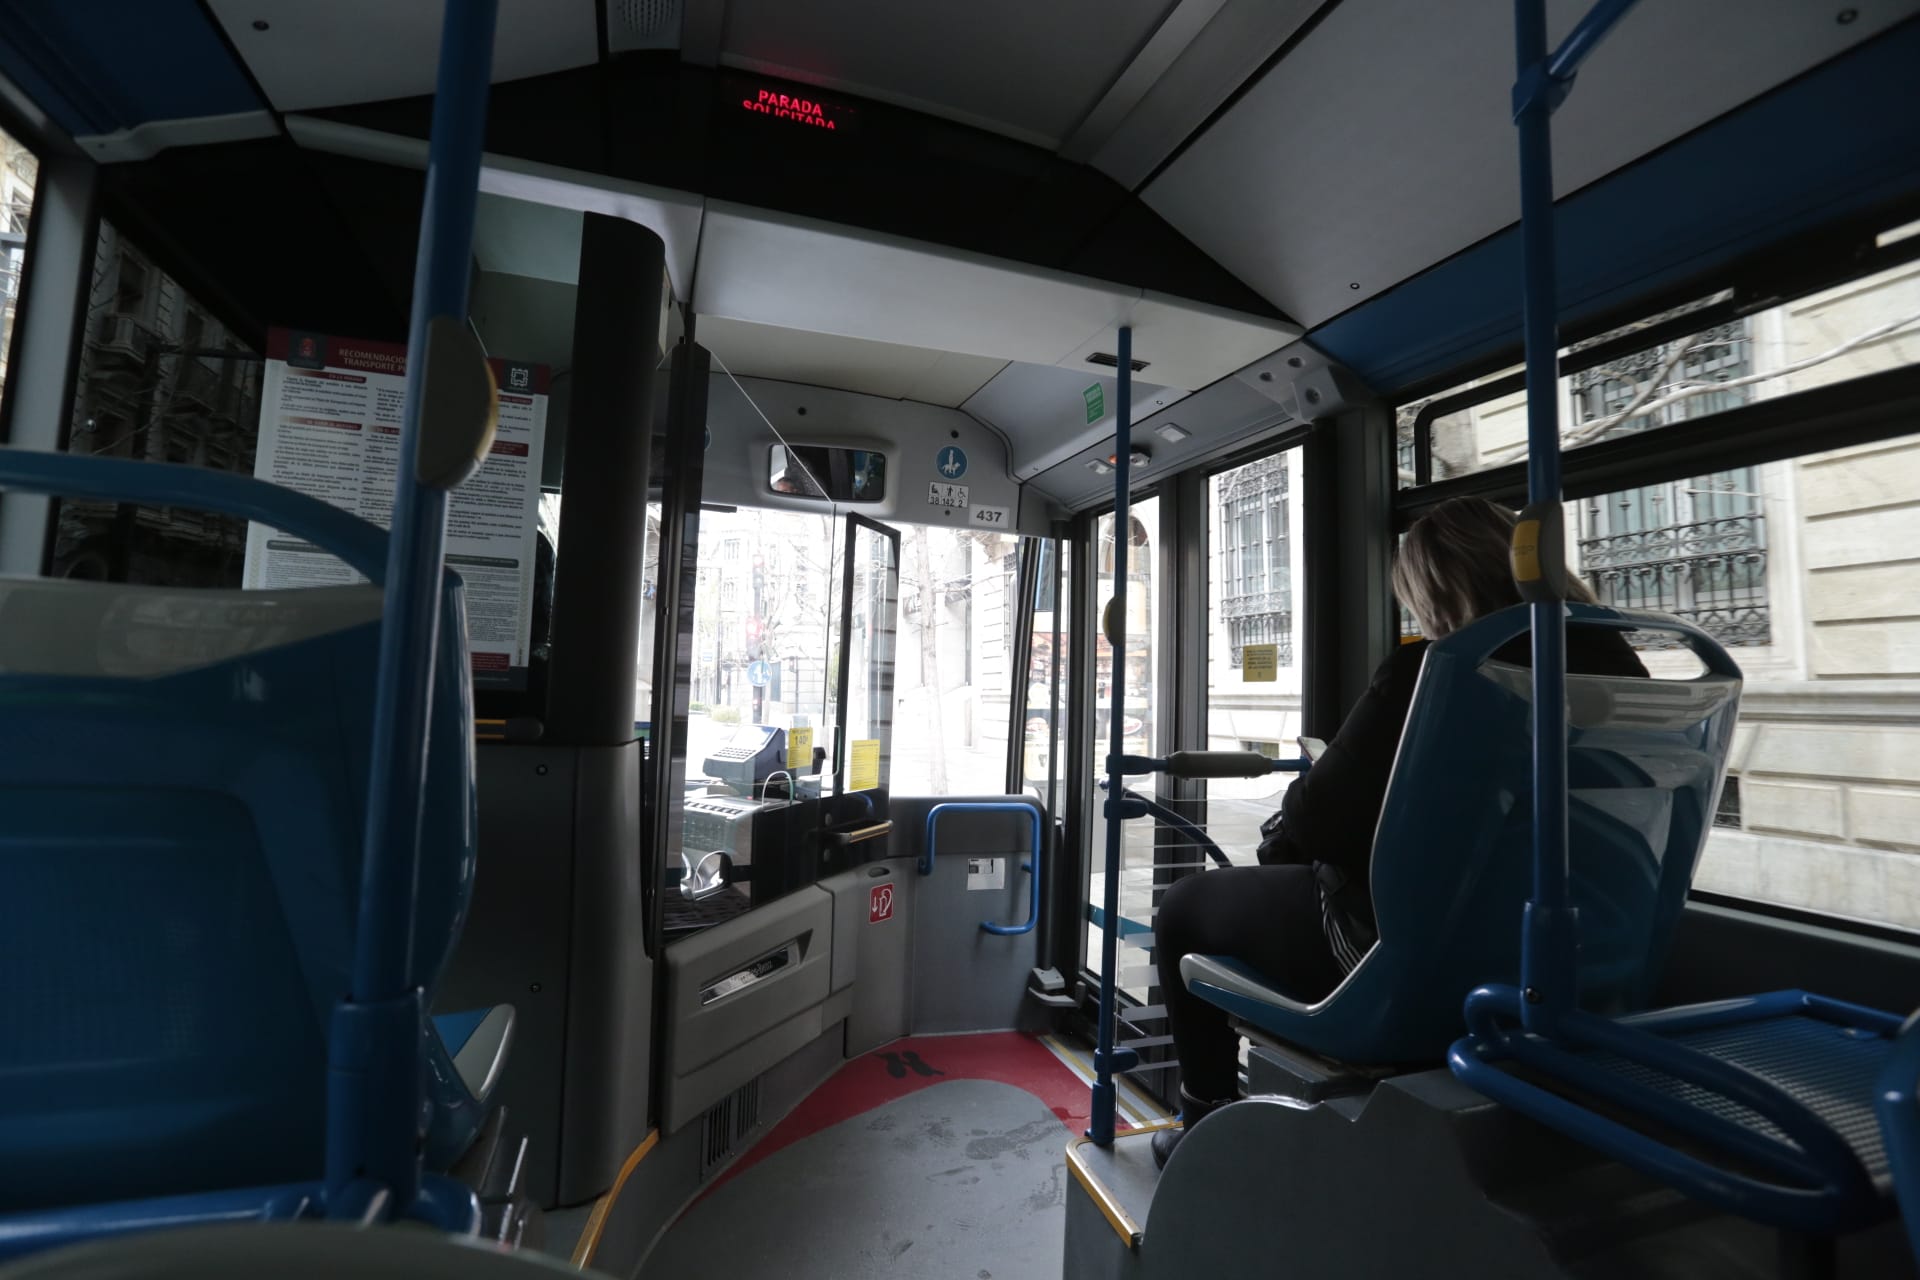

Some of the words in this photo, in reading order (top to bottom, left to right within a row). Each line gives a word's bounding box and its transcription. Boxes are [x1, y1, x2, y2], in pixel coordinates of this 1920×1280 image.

[758, 89, 823, 117] PARADA
[339, 348, 406, 364] RECOMENDACIO
[943, 498, 955, 507] 142
[958, 499, 963, 508] 2
[976, 510, 1002, 522] 437
